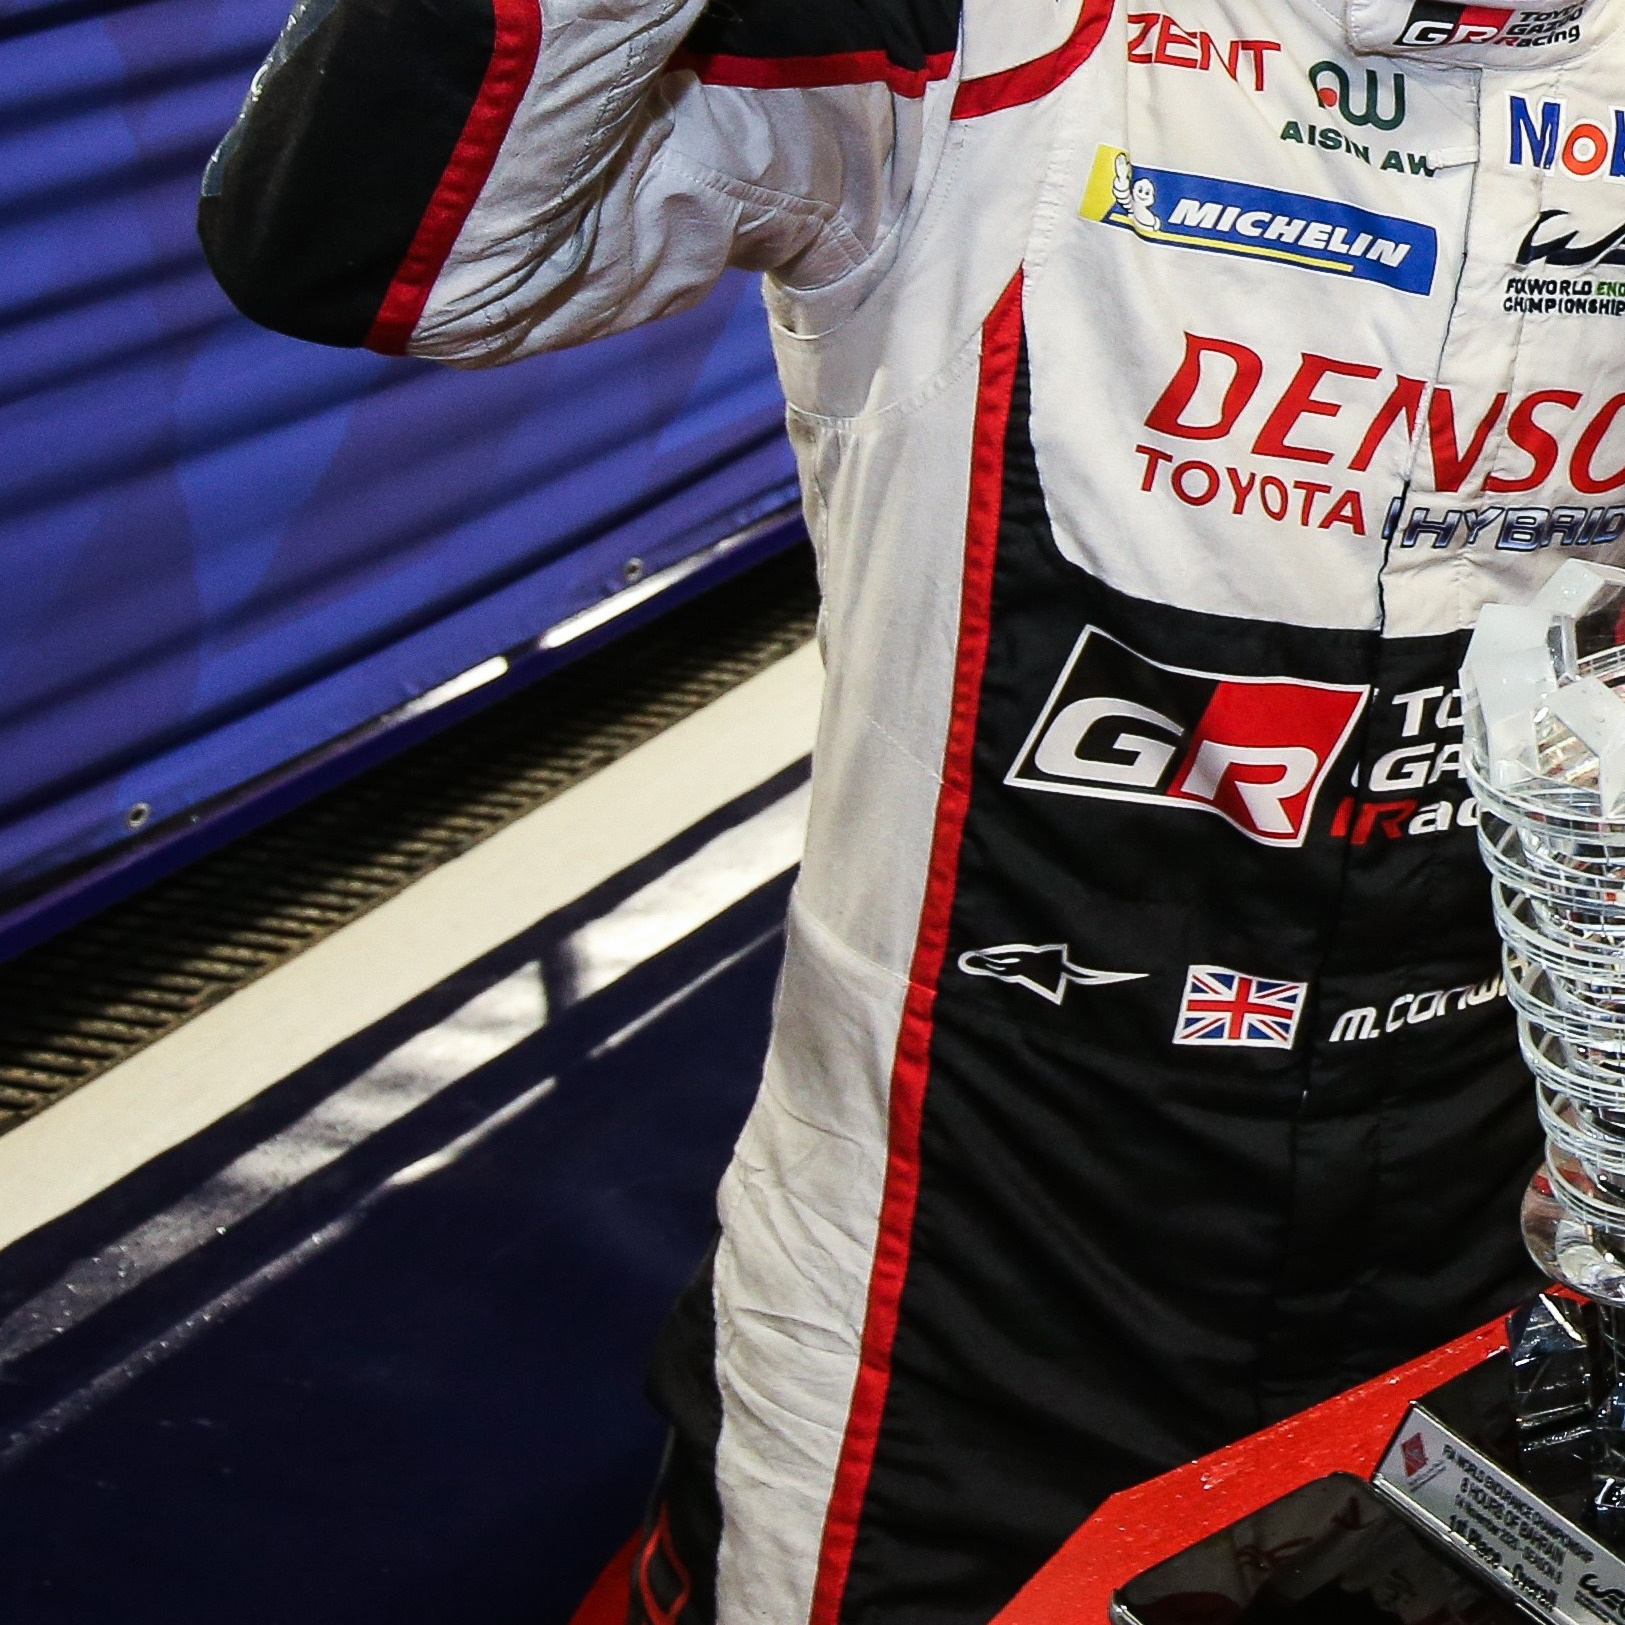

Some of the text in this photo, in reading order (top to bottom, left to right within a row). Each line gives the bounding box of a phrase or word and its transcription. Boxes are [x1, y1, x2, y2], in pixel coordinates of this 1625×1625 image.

[1126, 12, 1281, 92] ZENT
[1402, 20, 1581, 47] GR Racing
[1279, 120, 1371, 167] AISIN
[1168, 197, 1411, 269] MICHELIN
[1503, 297, 1625, 316] CHMPIONSHIP
[1527, 279, 1593, 295] WORLD
[1134, 443, 1367, 536] TOYOTA
[1034, 696, 1318, 834] GR
